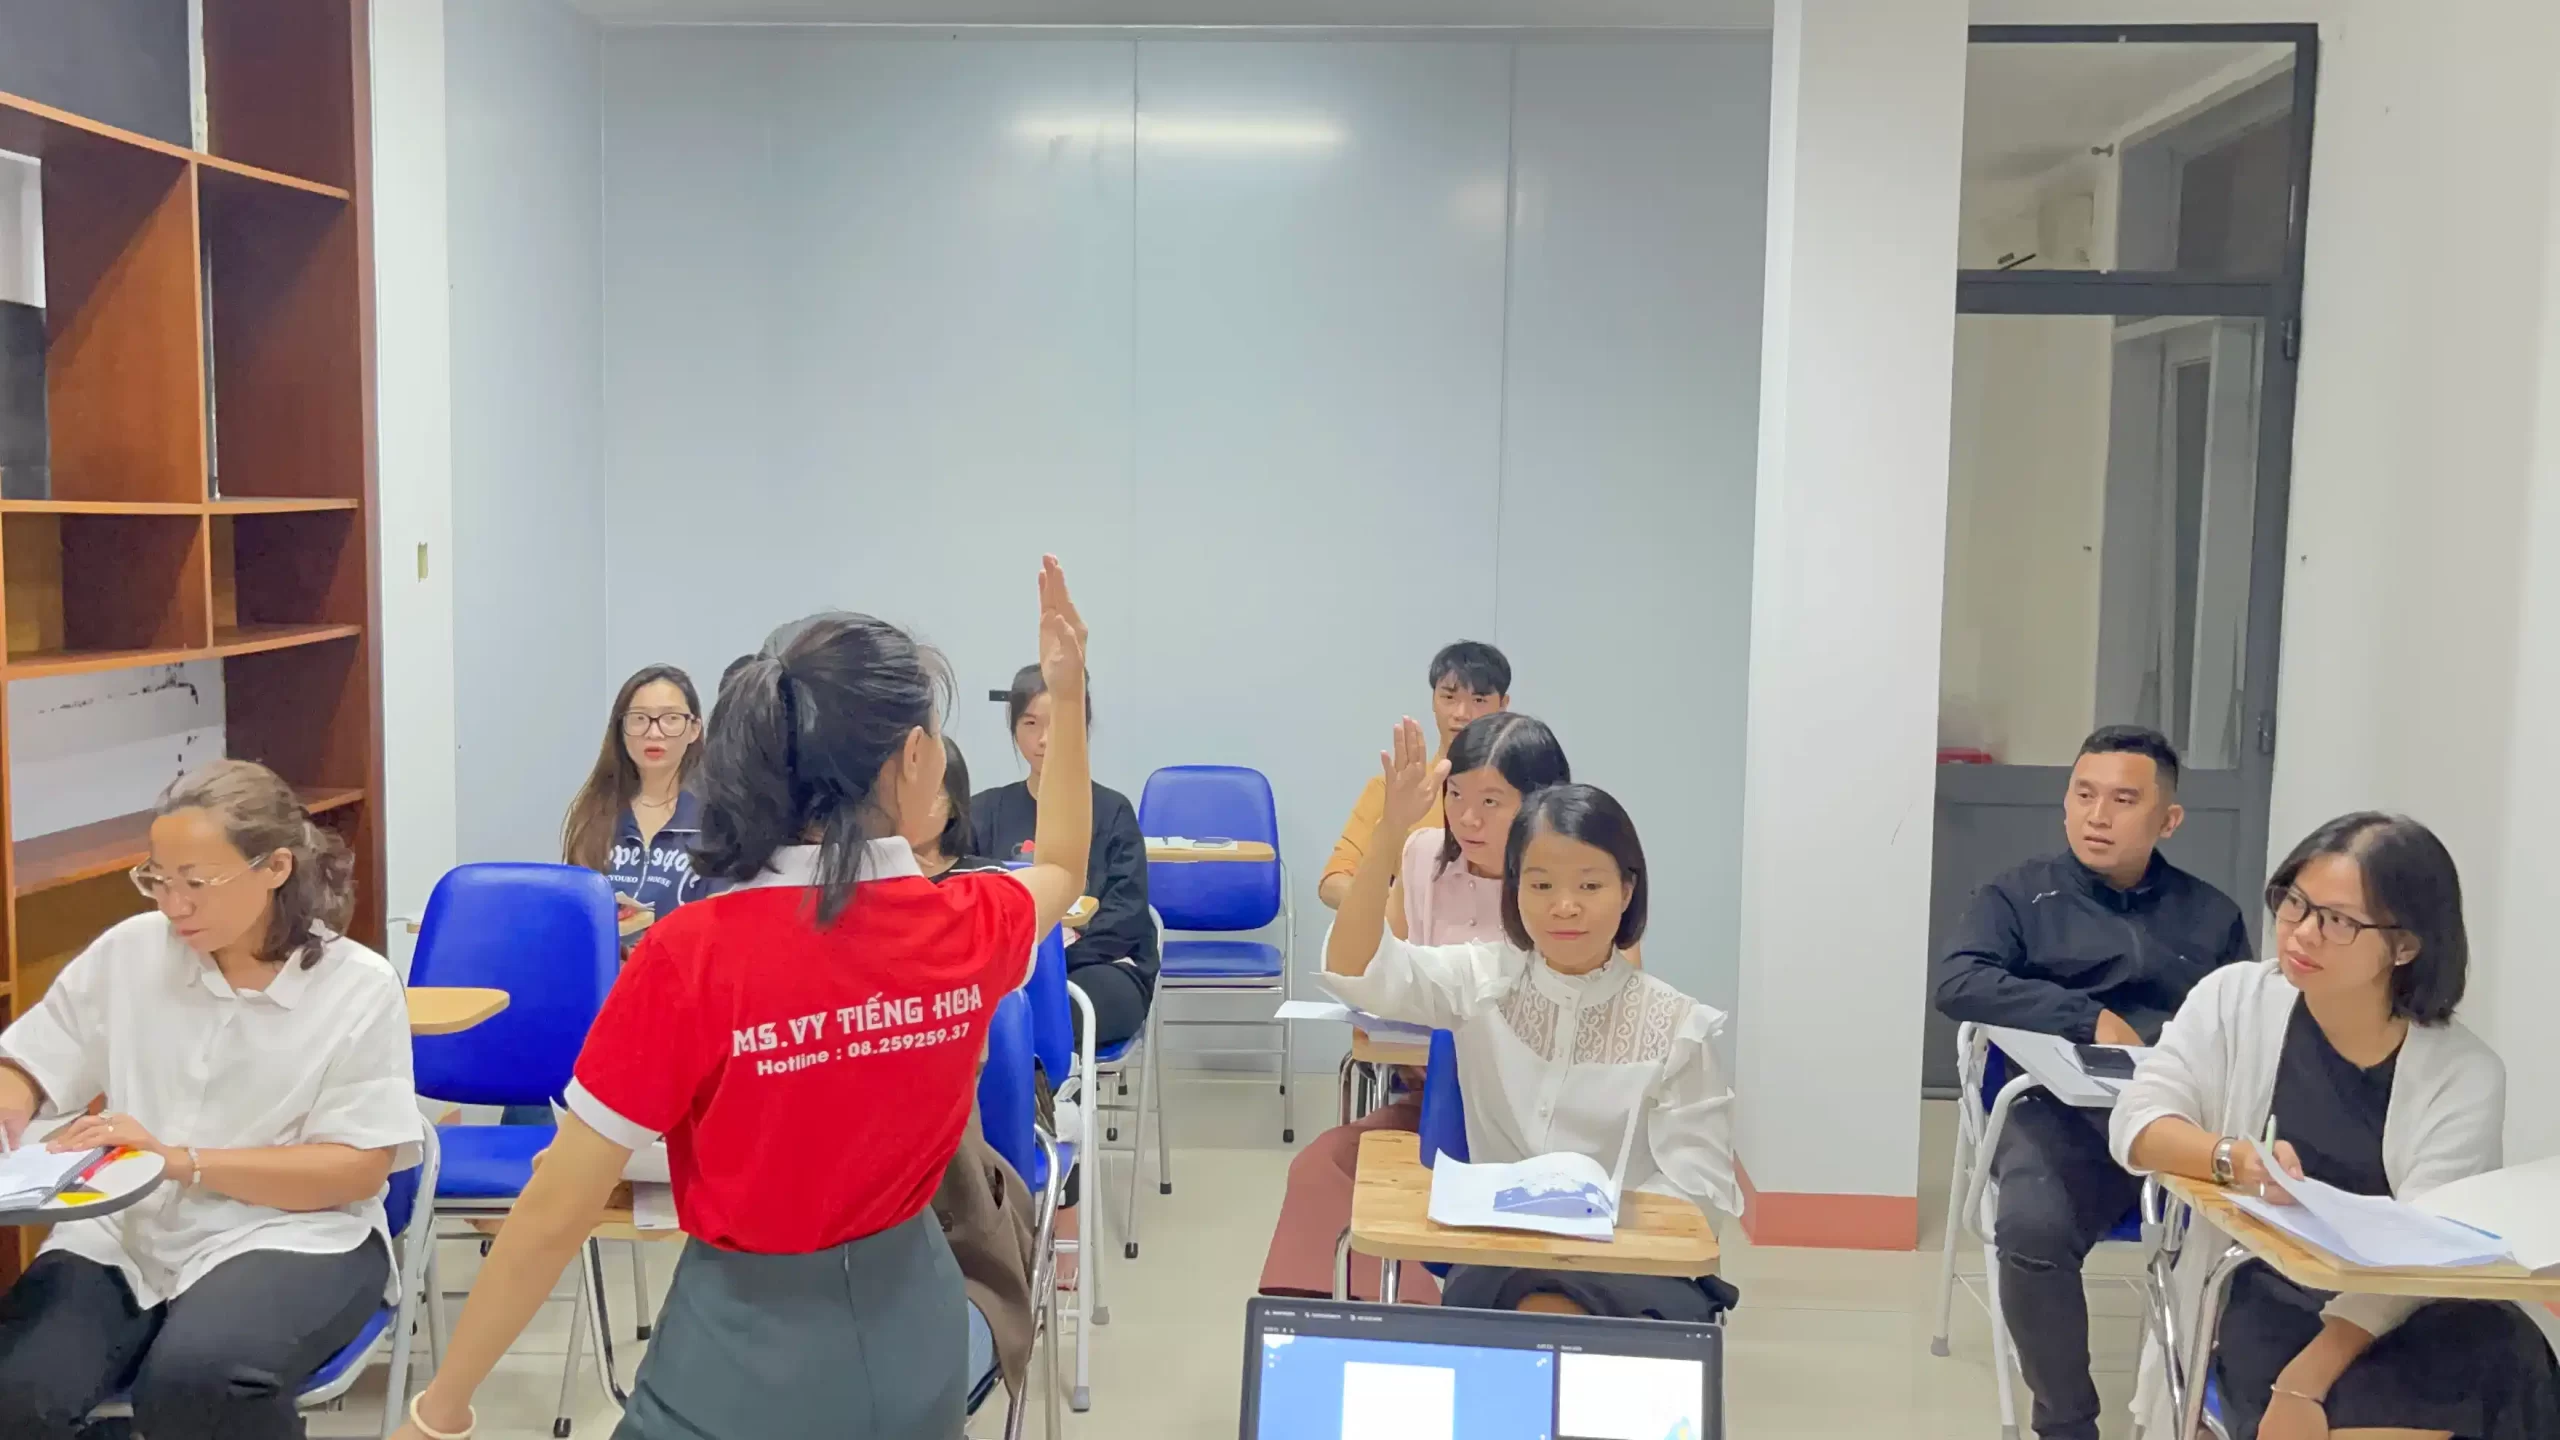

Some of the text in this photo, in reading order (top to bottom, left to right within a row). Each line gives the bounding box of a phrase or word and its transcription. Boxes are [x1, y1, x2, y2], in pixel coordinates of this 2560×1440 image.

[837, 992, 923, 1035] TIẾNG
[932, 984, 983, 1020] HOA
[757, 1049, 829, 1076] Hotline
[847, 1022, 970, 1058] 08.259259.37
